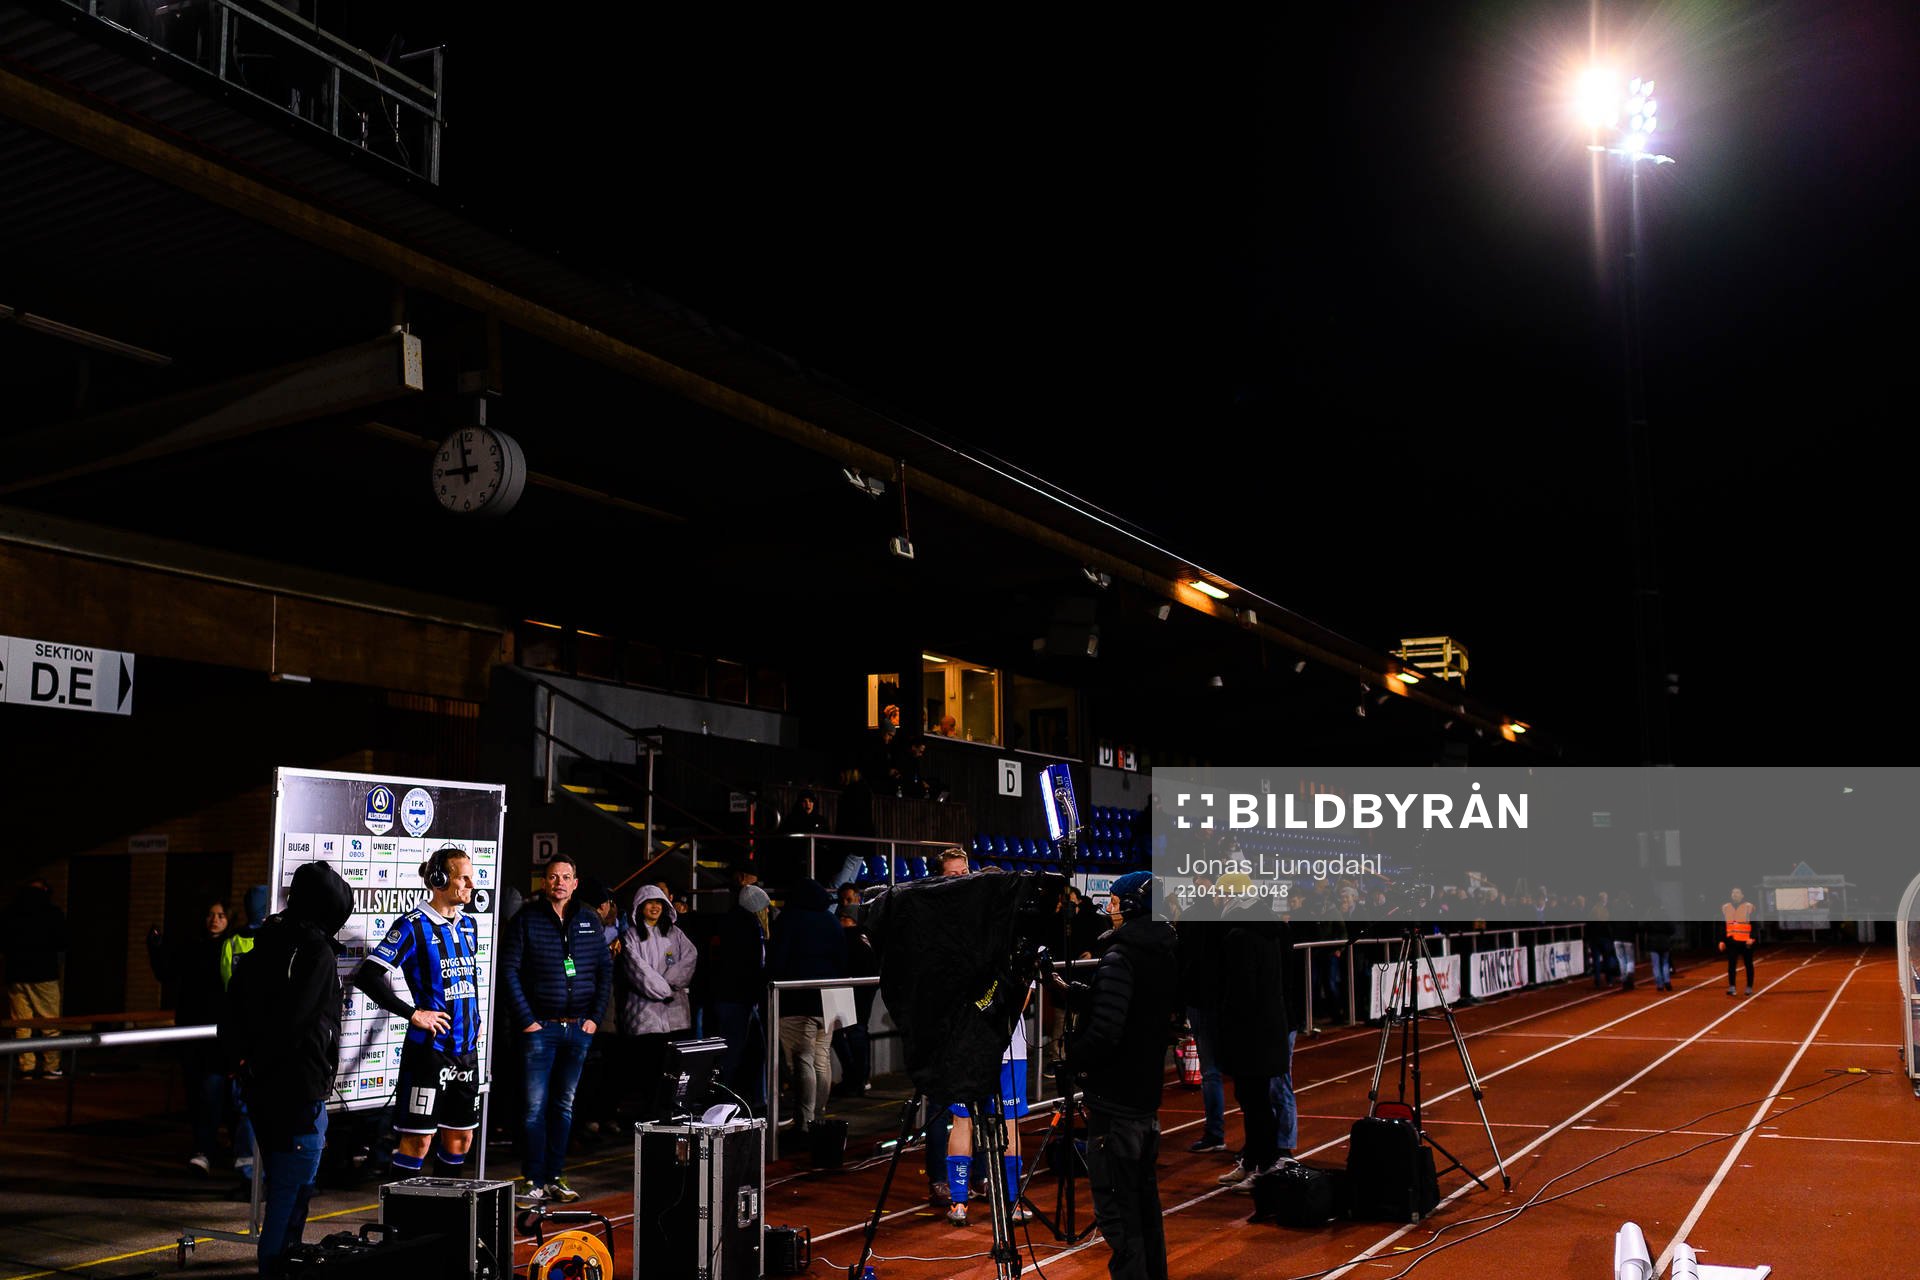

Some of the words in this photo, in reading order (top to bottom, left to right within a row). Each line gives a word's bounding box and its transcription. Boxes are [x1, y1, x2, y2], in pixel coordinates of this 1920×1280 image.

[35, 643, 93, 663] SEKTION
[31, 662, 93, 706] D.E
[1006, 769, 1015, 793] D
[373, 843, 396, 851] UNIBET
[540, 841, 552, 859] D
[344, 868, 368, 876] UNIBET
[478, 943, 489, 951] BET
[440, 957, 460, 969] BYGG
[390, 1023, 409, 1031] UNIBE
[361, 1051, 385, 1060] UNIBET
